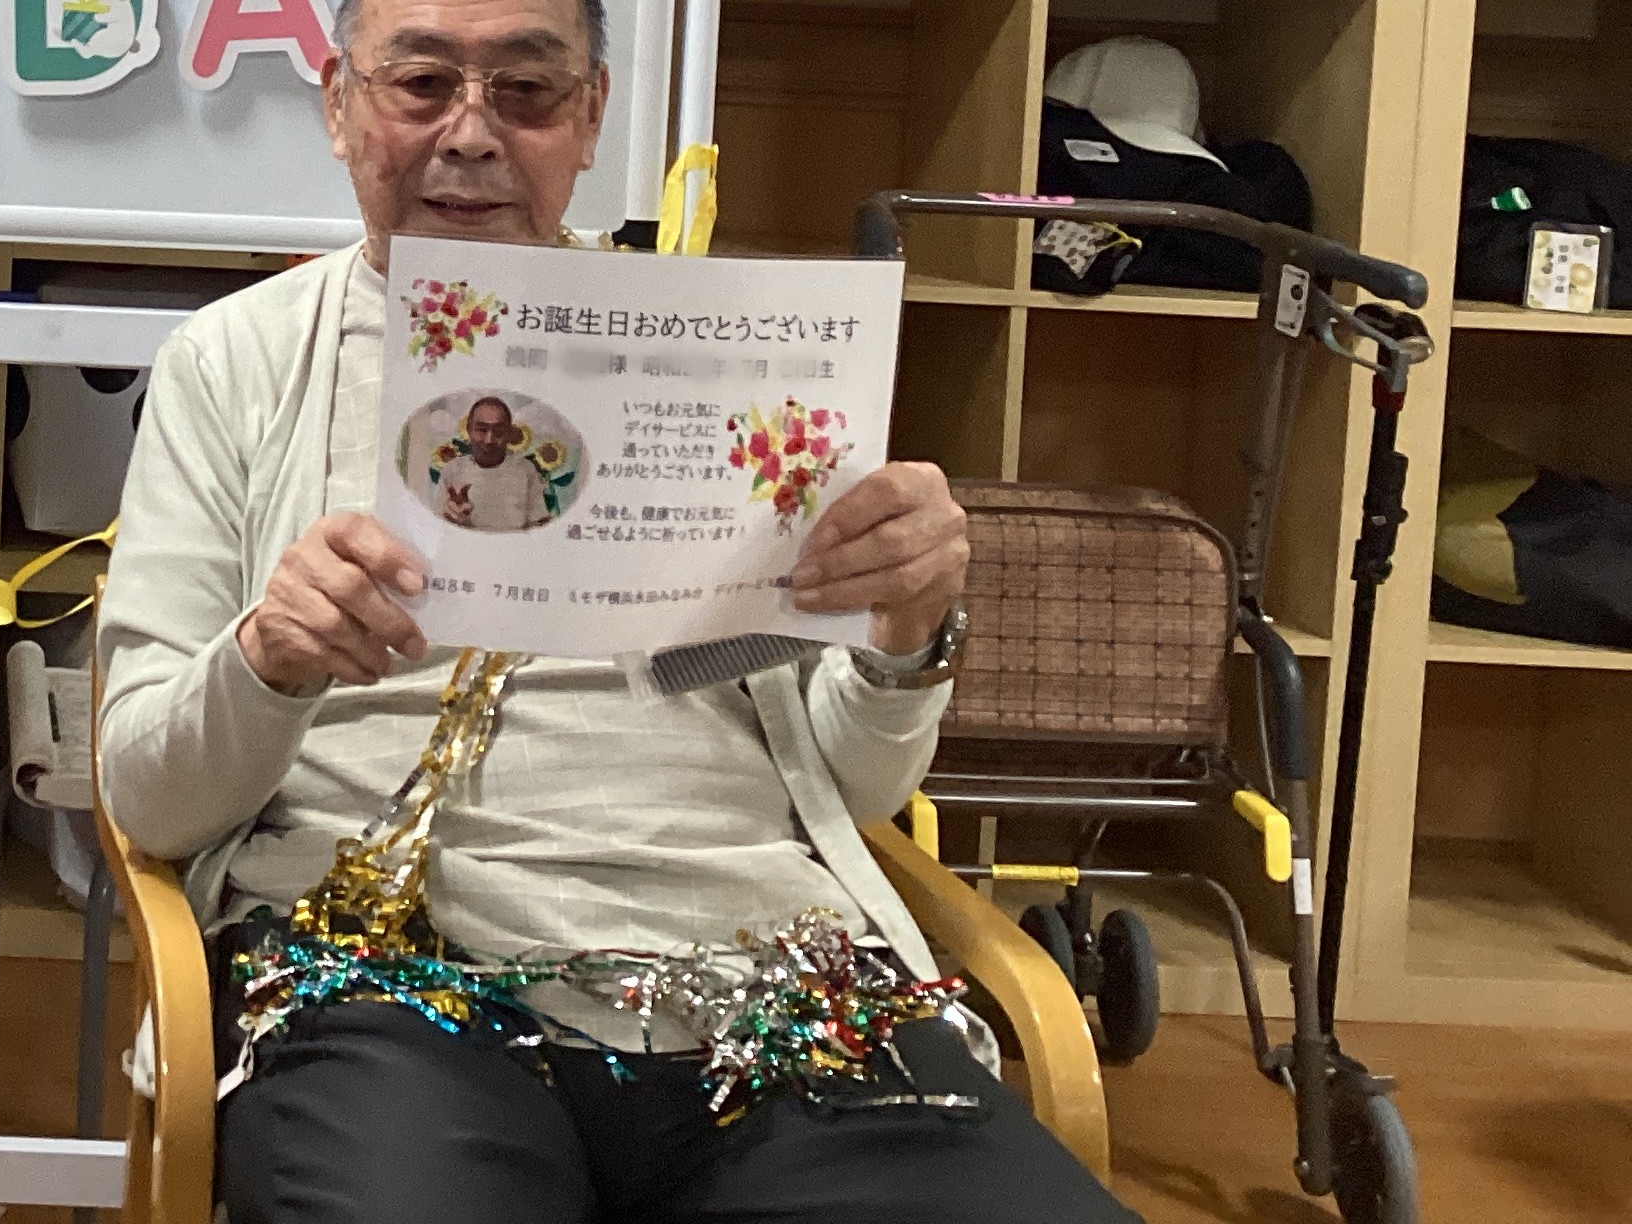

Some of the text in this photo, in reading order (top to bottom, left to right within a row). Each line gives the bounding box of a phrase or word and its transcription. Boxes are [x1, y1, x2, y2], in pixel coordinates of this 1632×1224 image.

[516, 303, 861, 344] お誕生日おめでとうございます
[623, 400, 721, 418] いつもお元気に
[624, 420, 717, 437] デイサービスに
[621, 442, 715, 459] 通っていただき
